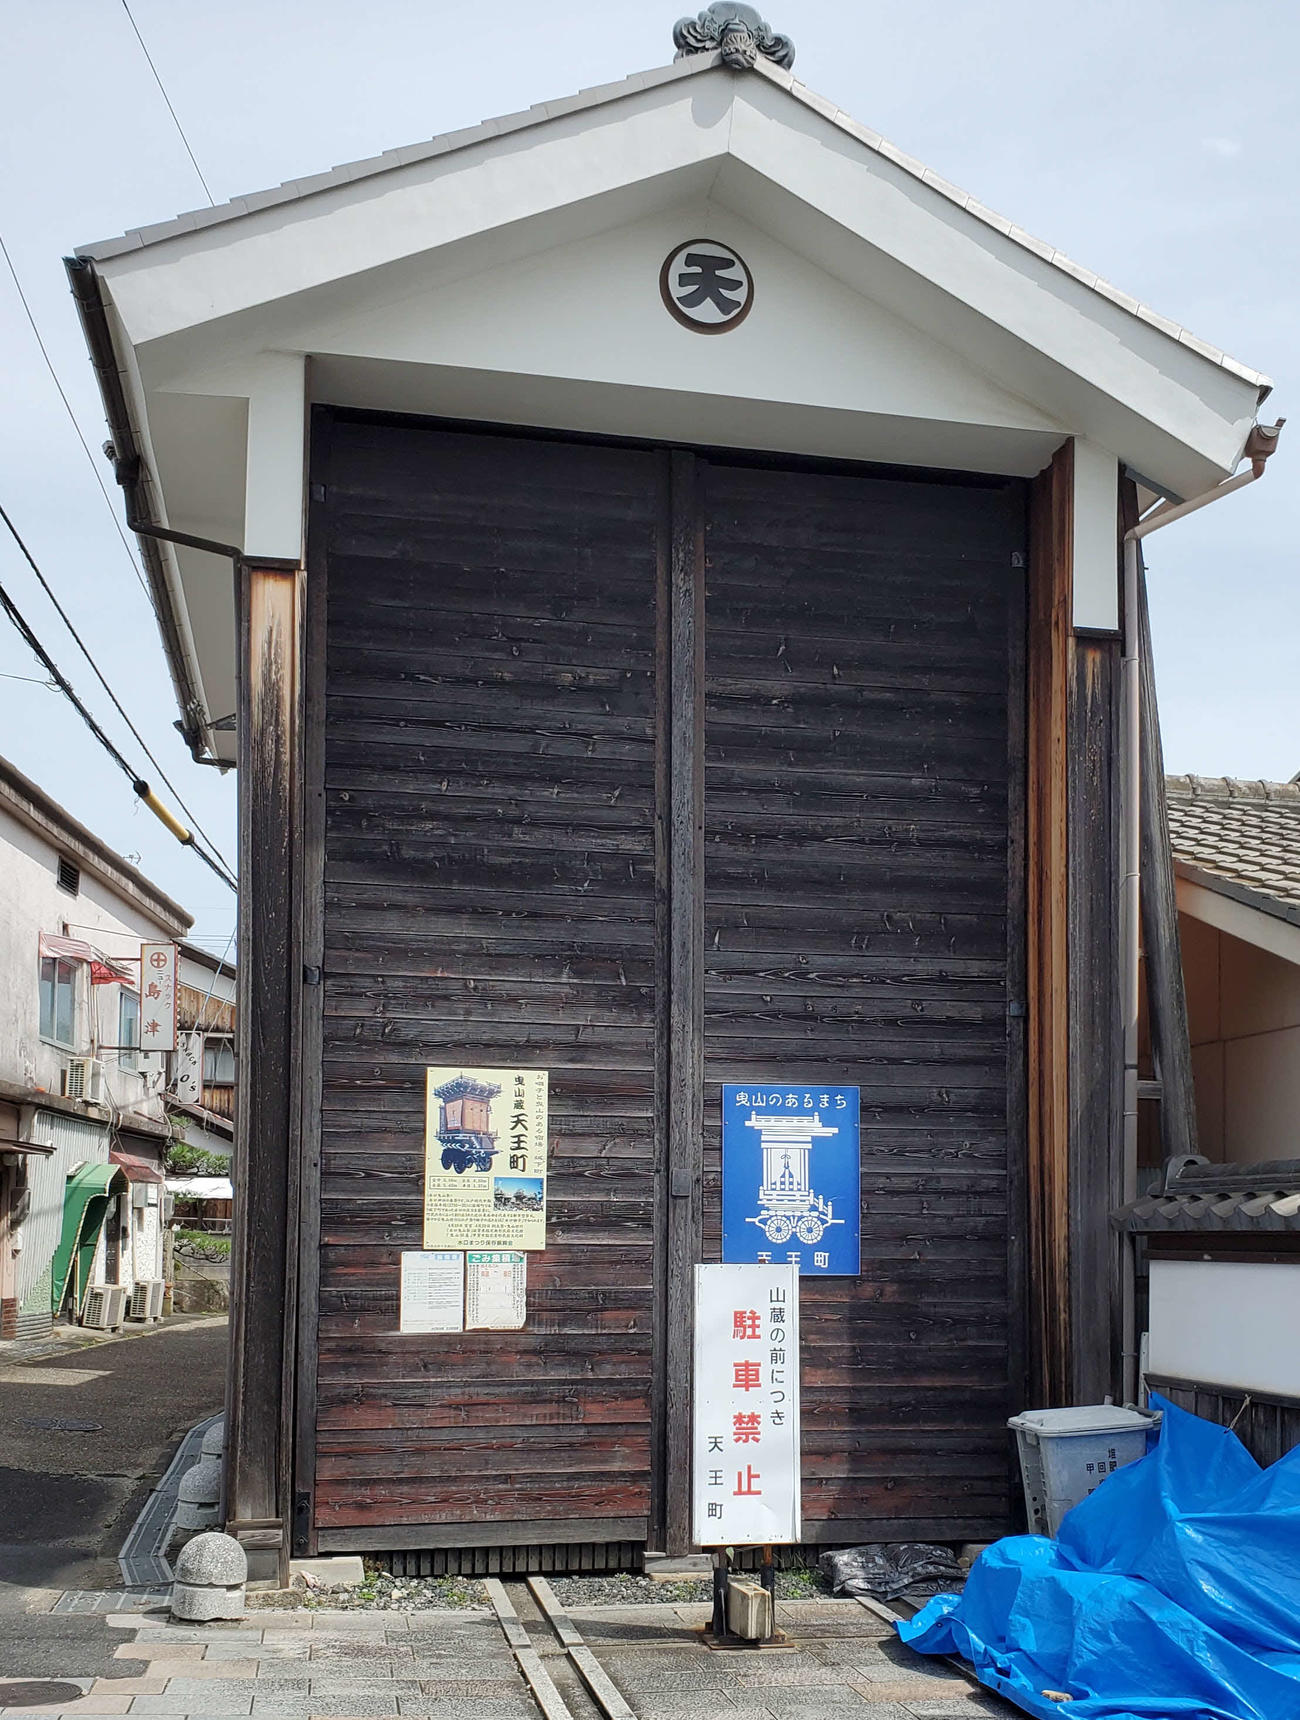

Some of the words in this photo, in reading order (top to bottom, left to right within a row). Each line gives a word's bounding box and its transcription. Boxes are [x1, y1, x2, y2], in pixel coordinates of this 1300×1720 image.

[676, 253, 743, 316] 天
[144, 981, 162, 1037] 島津
[735, 1091, 847, 1109] 曳山のあるまち
[769, 1286, 786, 1426] 山蔵の前につき
[732, 1309, 762, 1496] 駐車禁止
[707, 1435, 724, 1520] 天王町
